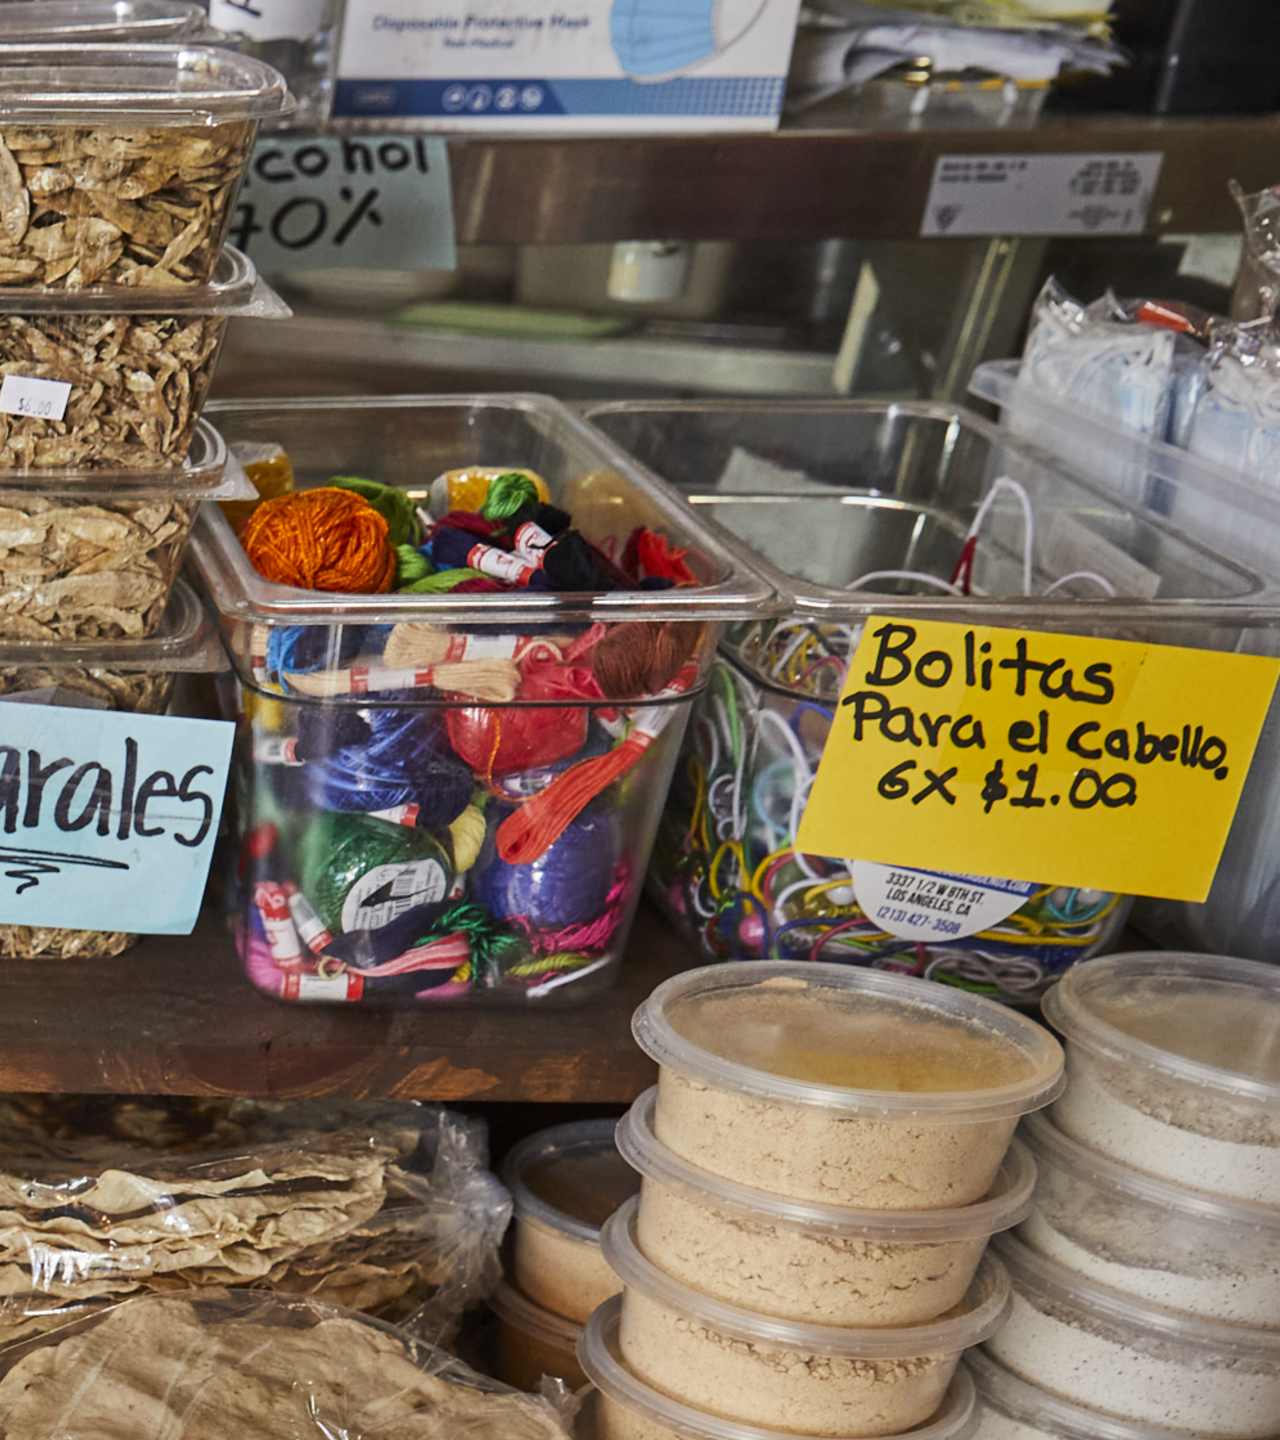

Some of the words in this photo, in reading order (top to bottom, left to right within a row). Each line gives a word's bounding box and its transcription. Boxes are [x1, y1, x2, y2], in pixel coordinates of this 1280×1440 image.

[243, 139, 429, 186] cohol
[865, 622, 1116, 704] Bolitas
[842, 691, 986, 750] Para
[1008, 711, 1049, 753] el
[980, 758, 1138, 814] $1.00
[885, 871, 912, 888] 3337
[917, 877, 937, 893] 1/2
[886, 888, 905, 902] LOS
[955, 903, 972, 916] CA
